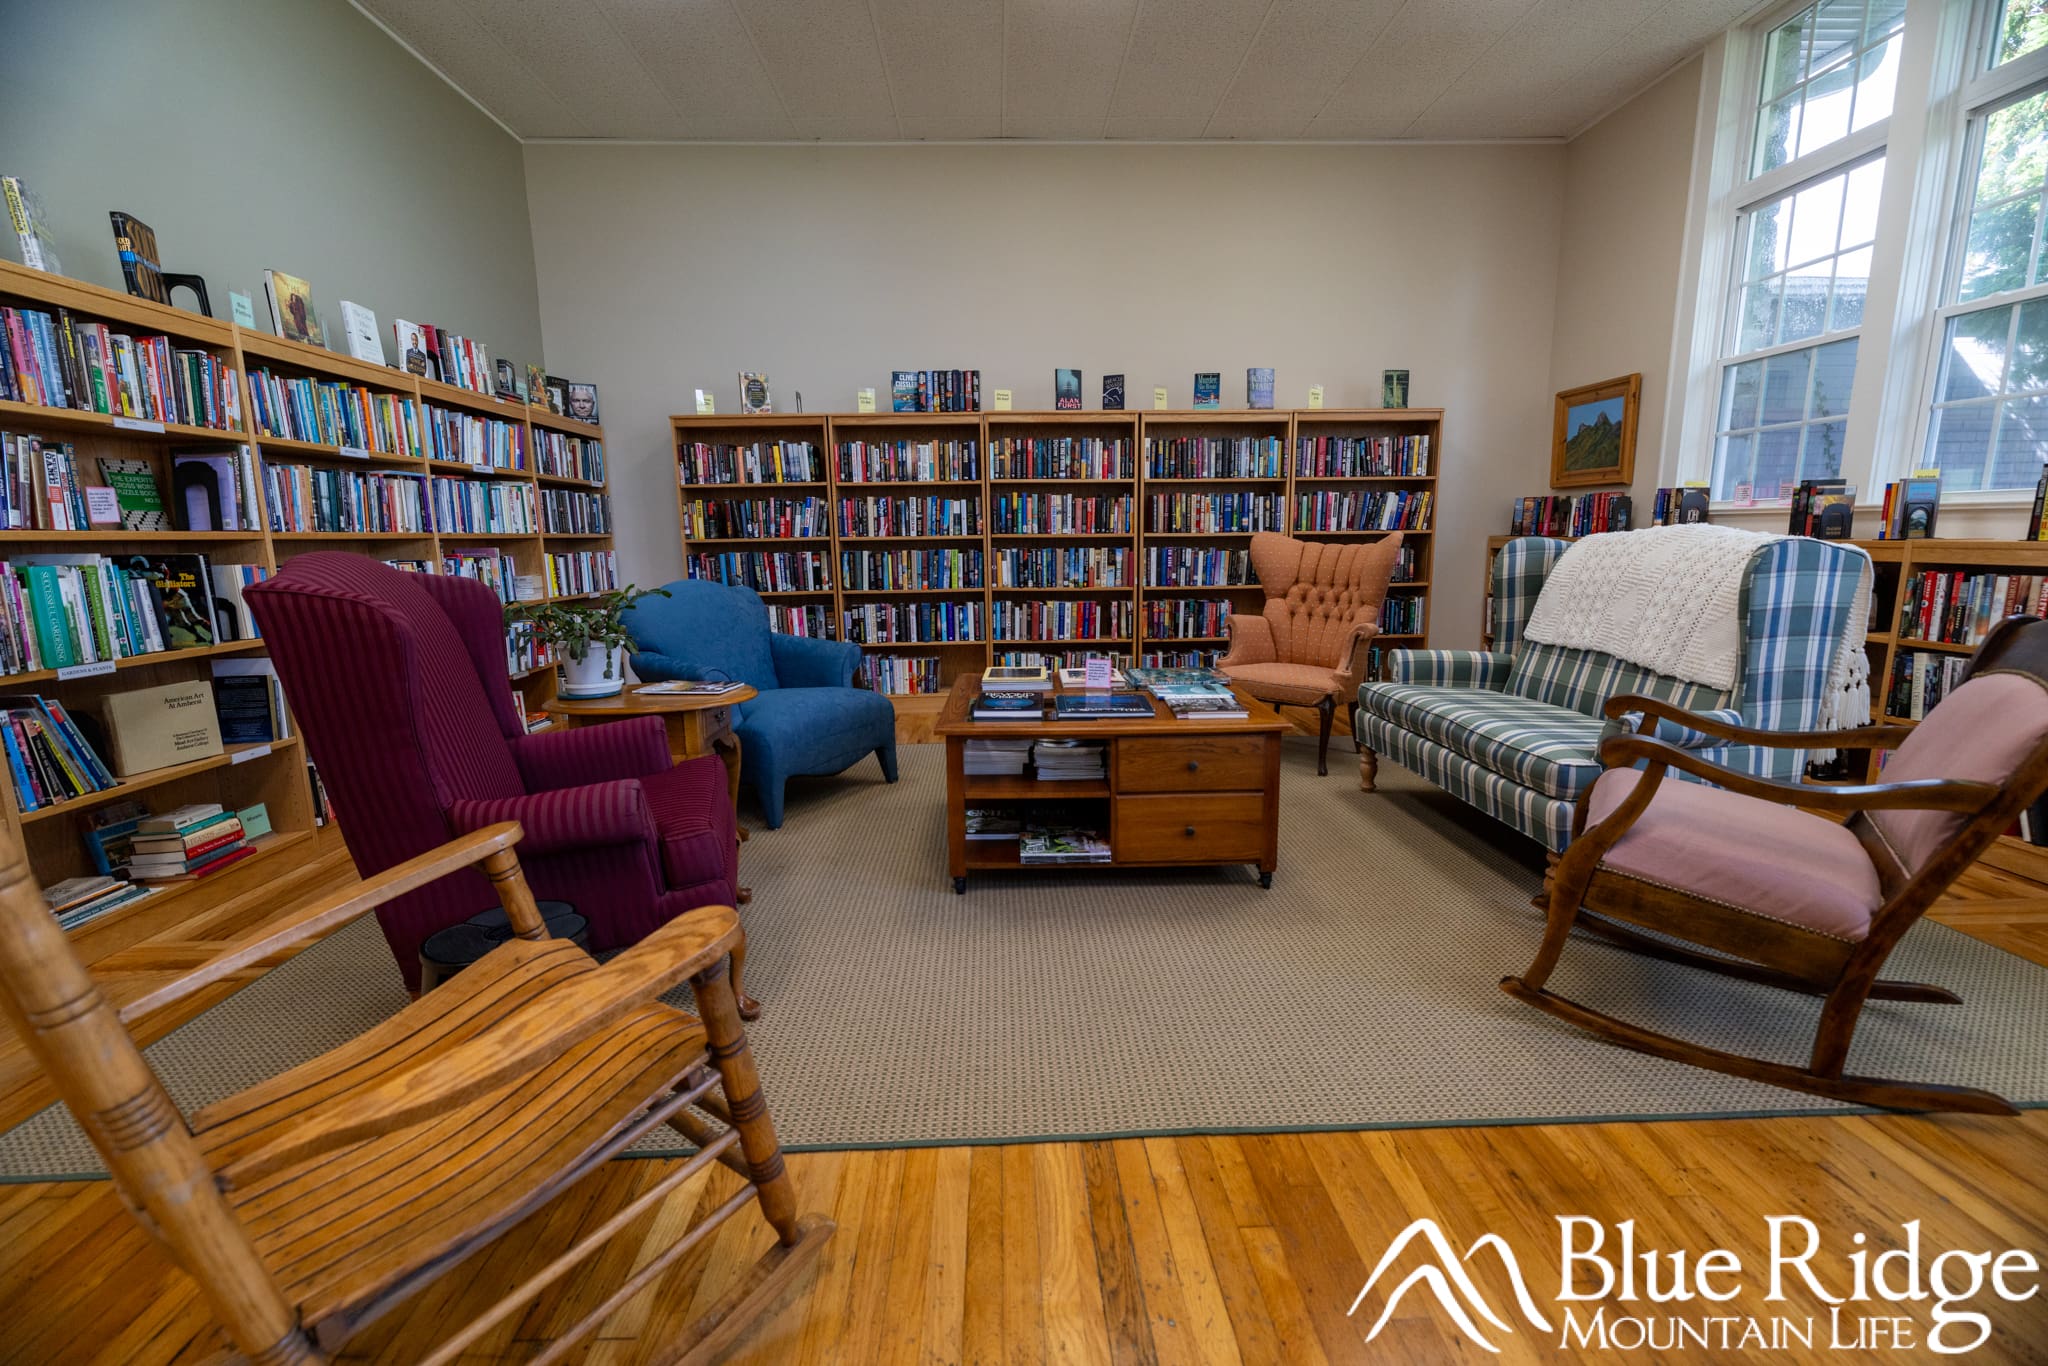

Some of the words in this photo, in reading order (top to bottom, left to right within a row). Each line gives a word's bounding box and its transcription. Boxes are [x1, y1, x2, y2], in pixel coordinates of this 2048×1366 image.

[45, 452, 55, 485] GAME
[178, 572, 195, 581] The
[155, 580, 196, 588] Gladiators
[41, 570, 56, 620] SUCCESSFUL
[51, 619, 66, 662] GARDENING
[61, 667, 87, 677] GARDENS
[92, 664, 113, 672] PLANTS
[164, 694, 193, 705] American
[176, 699, 202, 709] Amherst
